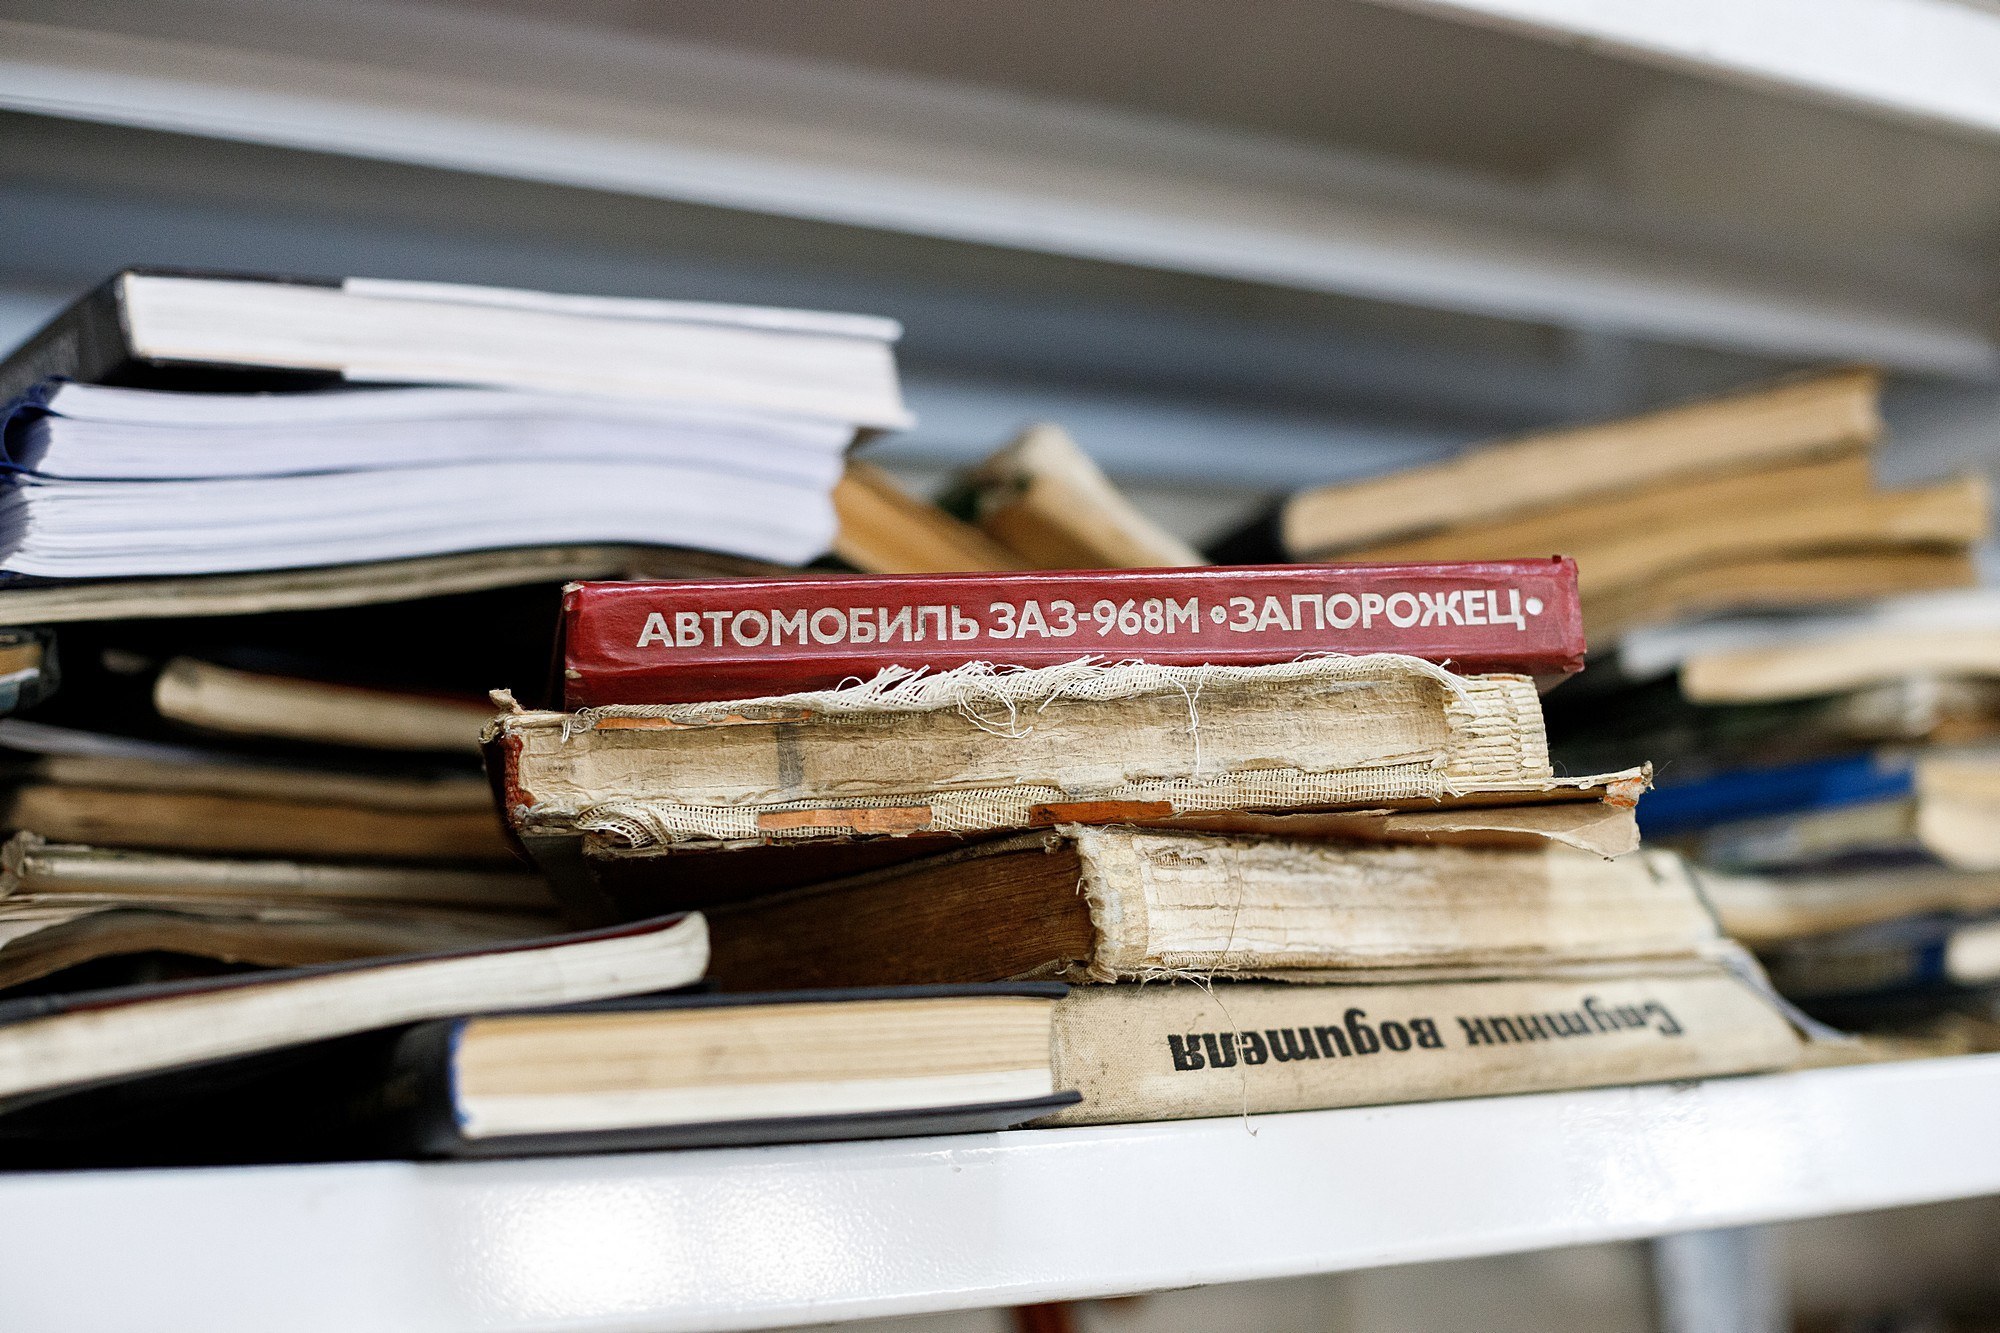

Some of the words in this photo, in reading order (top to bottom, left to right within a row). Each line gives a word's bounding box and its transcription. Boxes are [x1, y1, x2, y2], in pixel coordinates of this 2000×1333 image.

[636, 604, 980, 648] АВТОМОБИЛЬ
[988, 597, 1200, 640] ЗАЗ-968М
[1230, 588, 1526, 632] ЗАПОРОЖЕЦ
